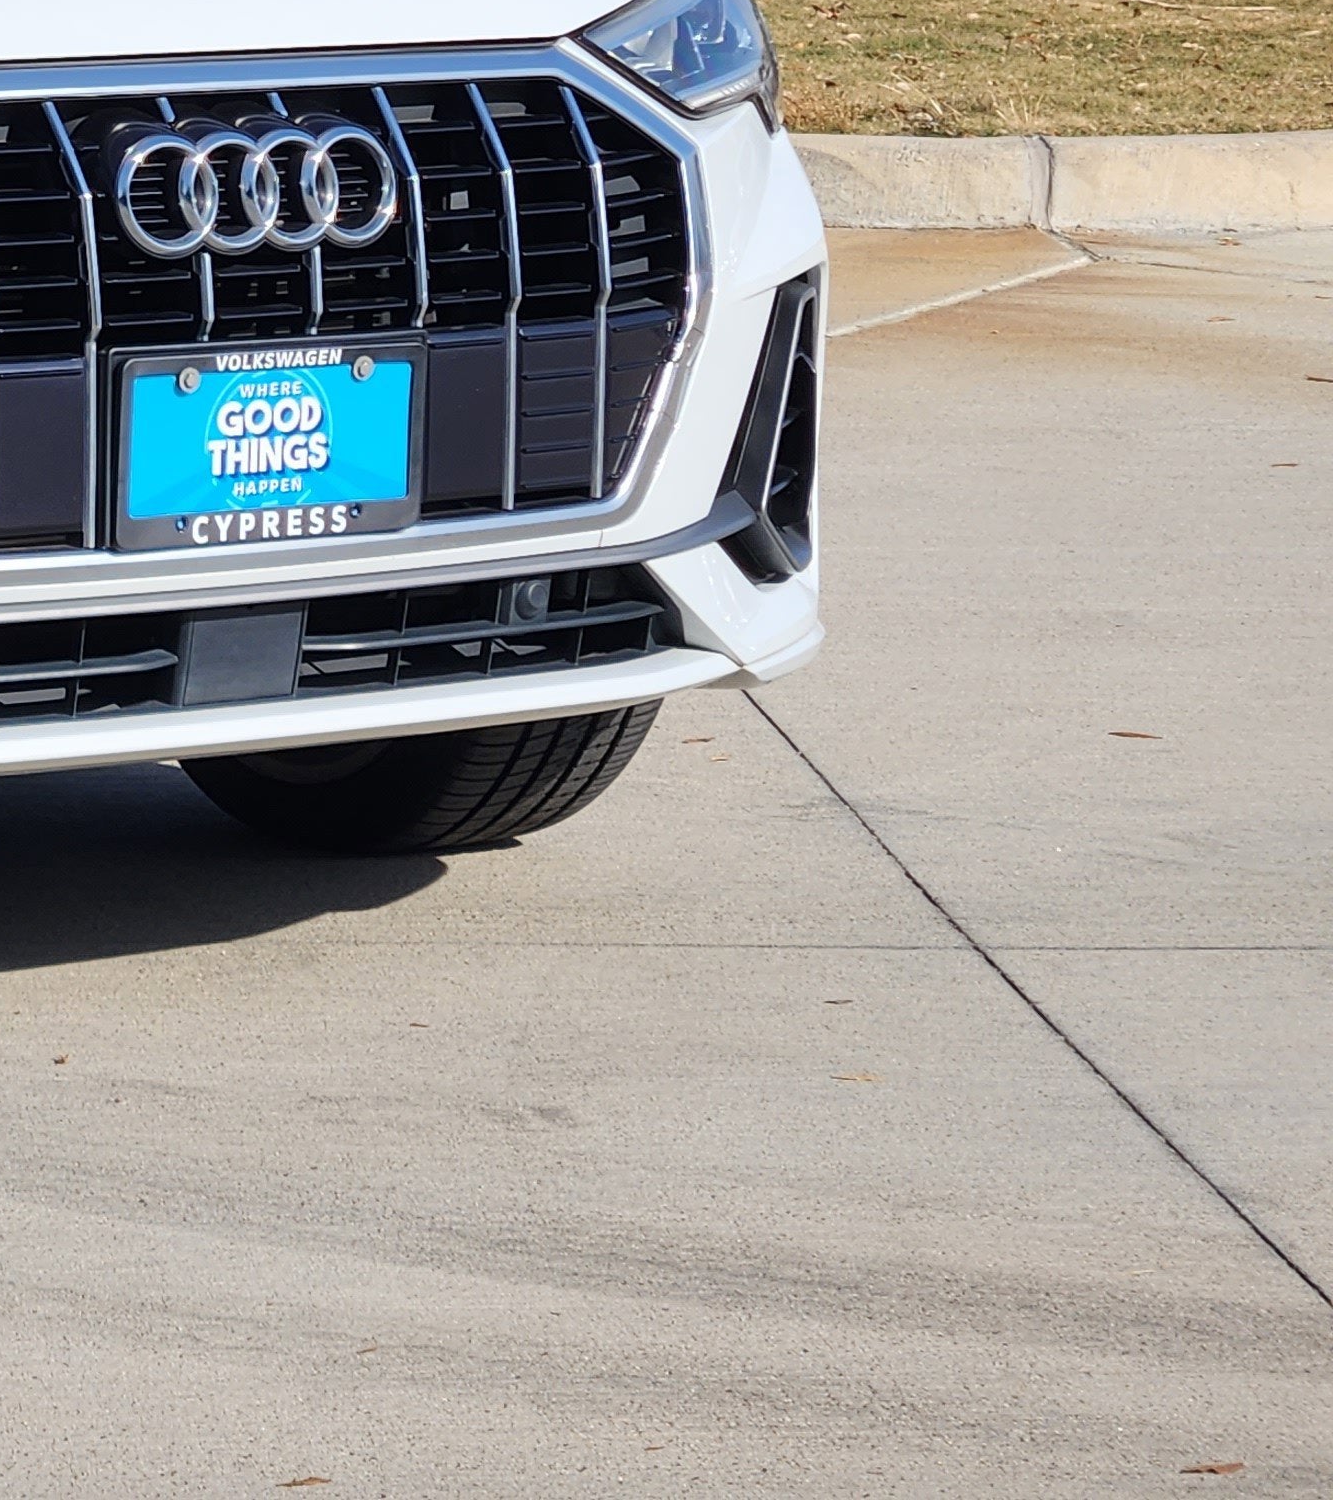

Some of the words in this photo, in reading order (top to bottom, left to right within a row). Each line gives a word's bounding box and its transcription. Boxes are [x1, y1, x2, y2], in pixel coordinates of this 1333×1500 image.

[216, 348, 343, 372] VOLKSWAGEN
[239, 381, 302, 398] WHERE
[217, 396, 322, 436] GOOD
[207, 433, 328, 476] THINGS
[232, 478, 303, 497] HAPPEN
[192, 505, 347, 545] CYPRESS
